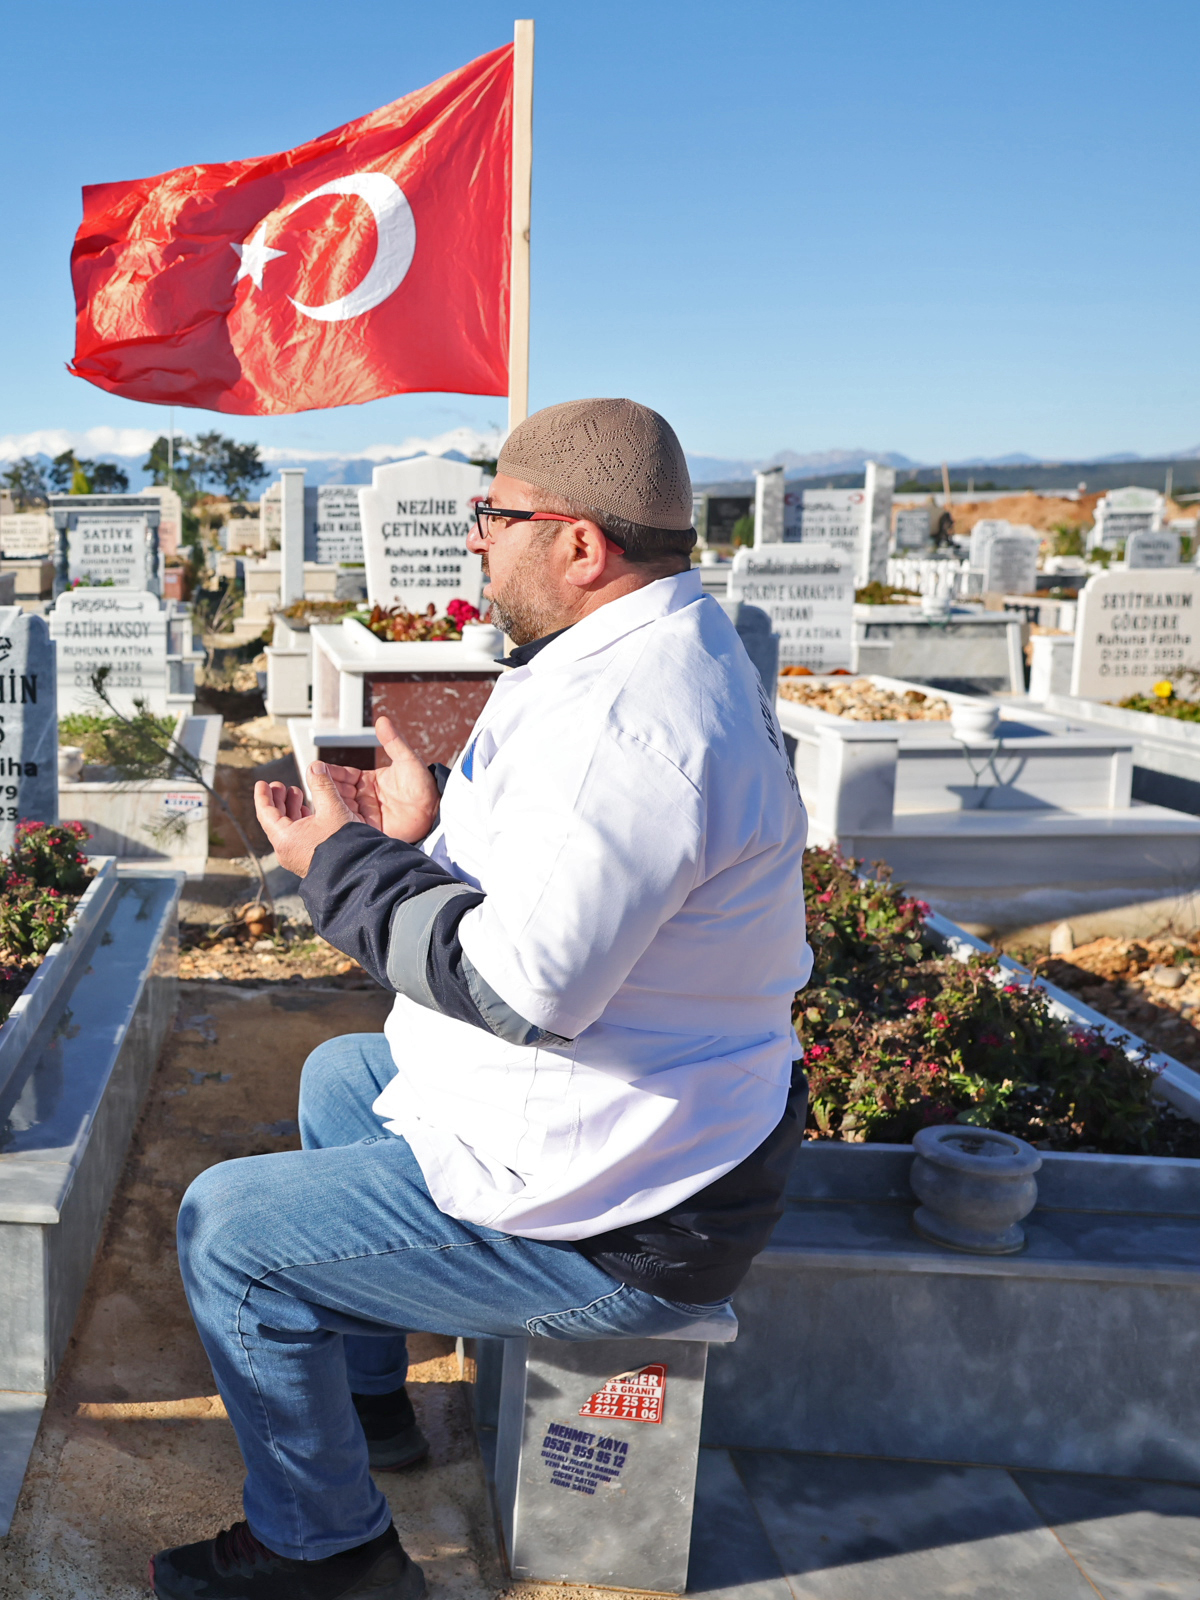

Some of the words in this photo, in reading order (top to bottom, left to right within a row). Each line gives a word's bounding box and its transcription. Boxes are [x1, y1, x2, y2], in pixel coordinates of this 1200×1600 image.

[397, 497, 457, 515] NEZİHE
[83, 528, 133, 539] SATİYE
[382, 519, 470, 541] ÇETİNKAYA
[83, 543, 133, 555] ERDEM
[385, 547, 428, 557] Ruhuna
[432, 547, 467, 557] Fatiha
[65, 619, 102, 637] FATİH
[107, 621, 151, 638] AKSOY
[63, 646, 110, 655] RUHUNA
[114, 645, 153, 655] FATİHA
[595, 1394, 620, 1405] 237
[622, 1396, 639, 1407] 25
[642, 1397, 658, 1408] 32
[594, 1404, 619, 1416] 227
[622, 1407, 637, 1418] 71
[641, 1409, 657, 1419] 06
[547, 1423, 596, 1445] MEHMET
[597, 1436, 629, 1455] KAYA
[543, 1436, 572, 1453] 0536
[572, 1444, 595, 1460] 959
[596, 1450, 612, 1464] 95
[613, 1455, 626, 1468] 12
